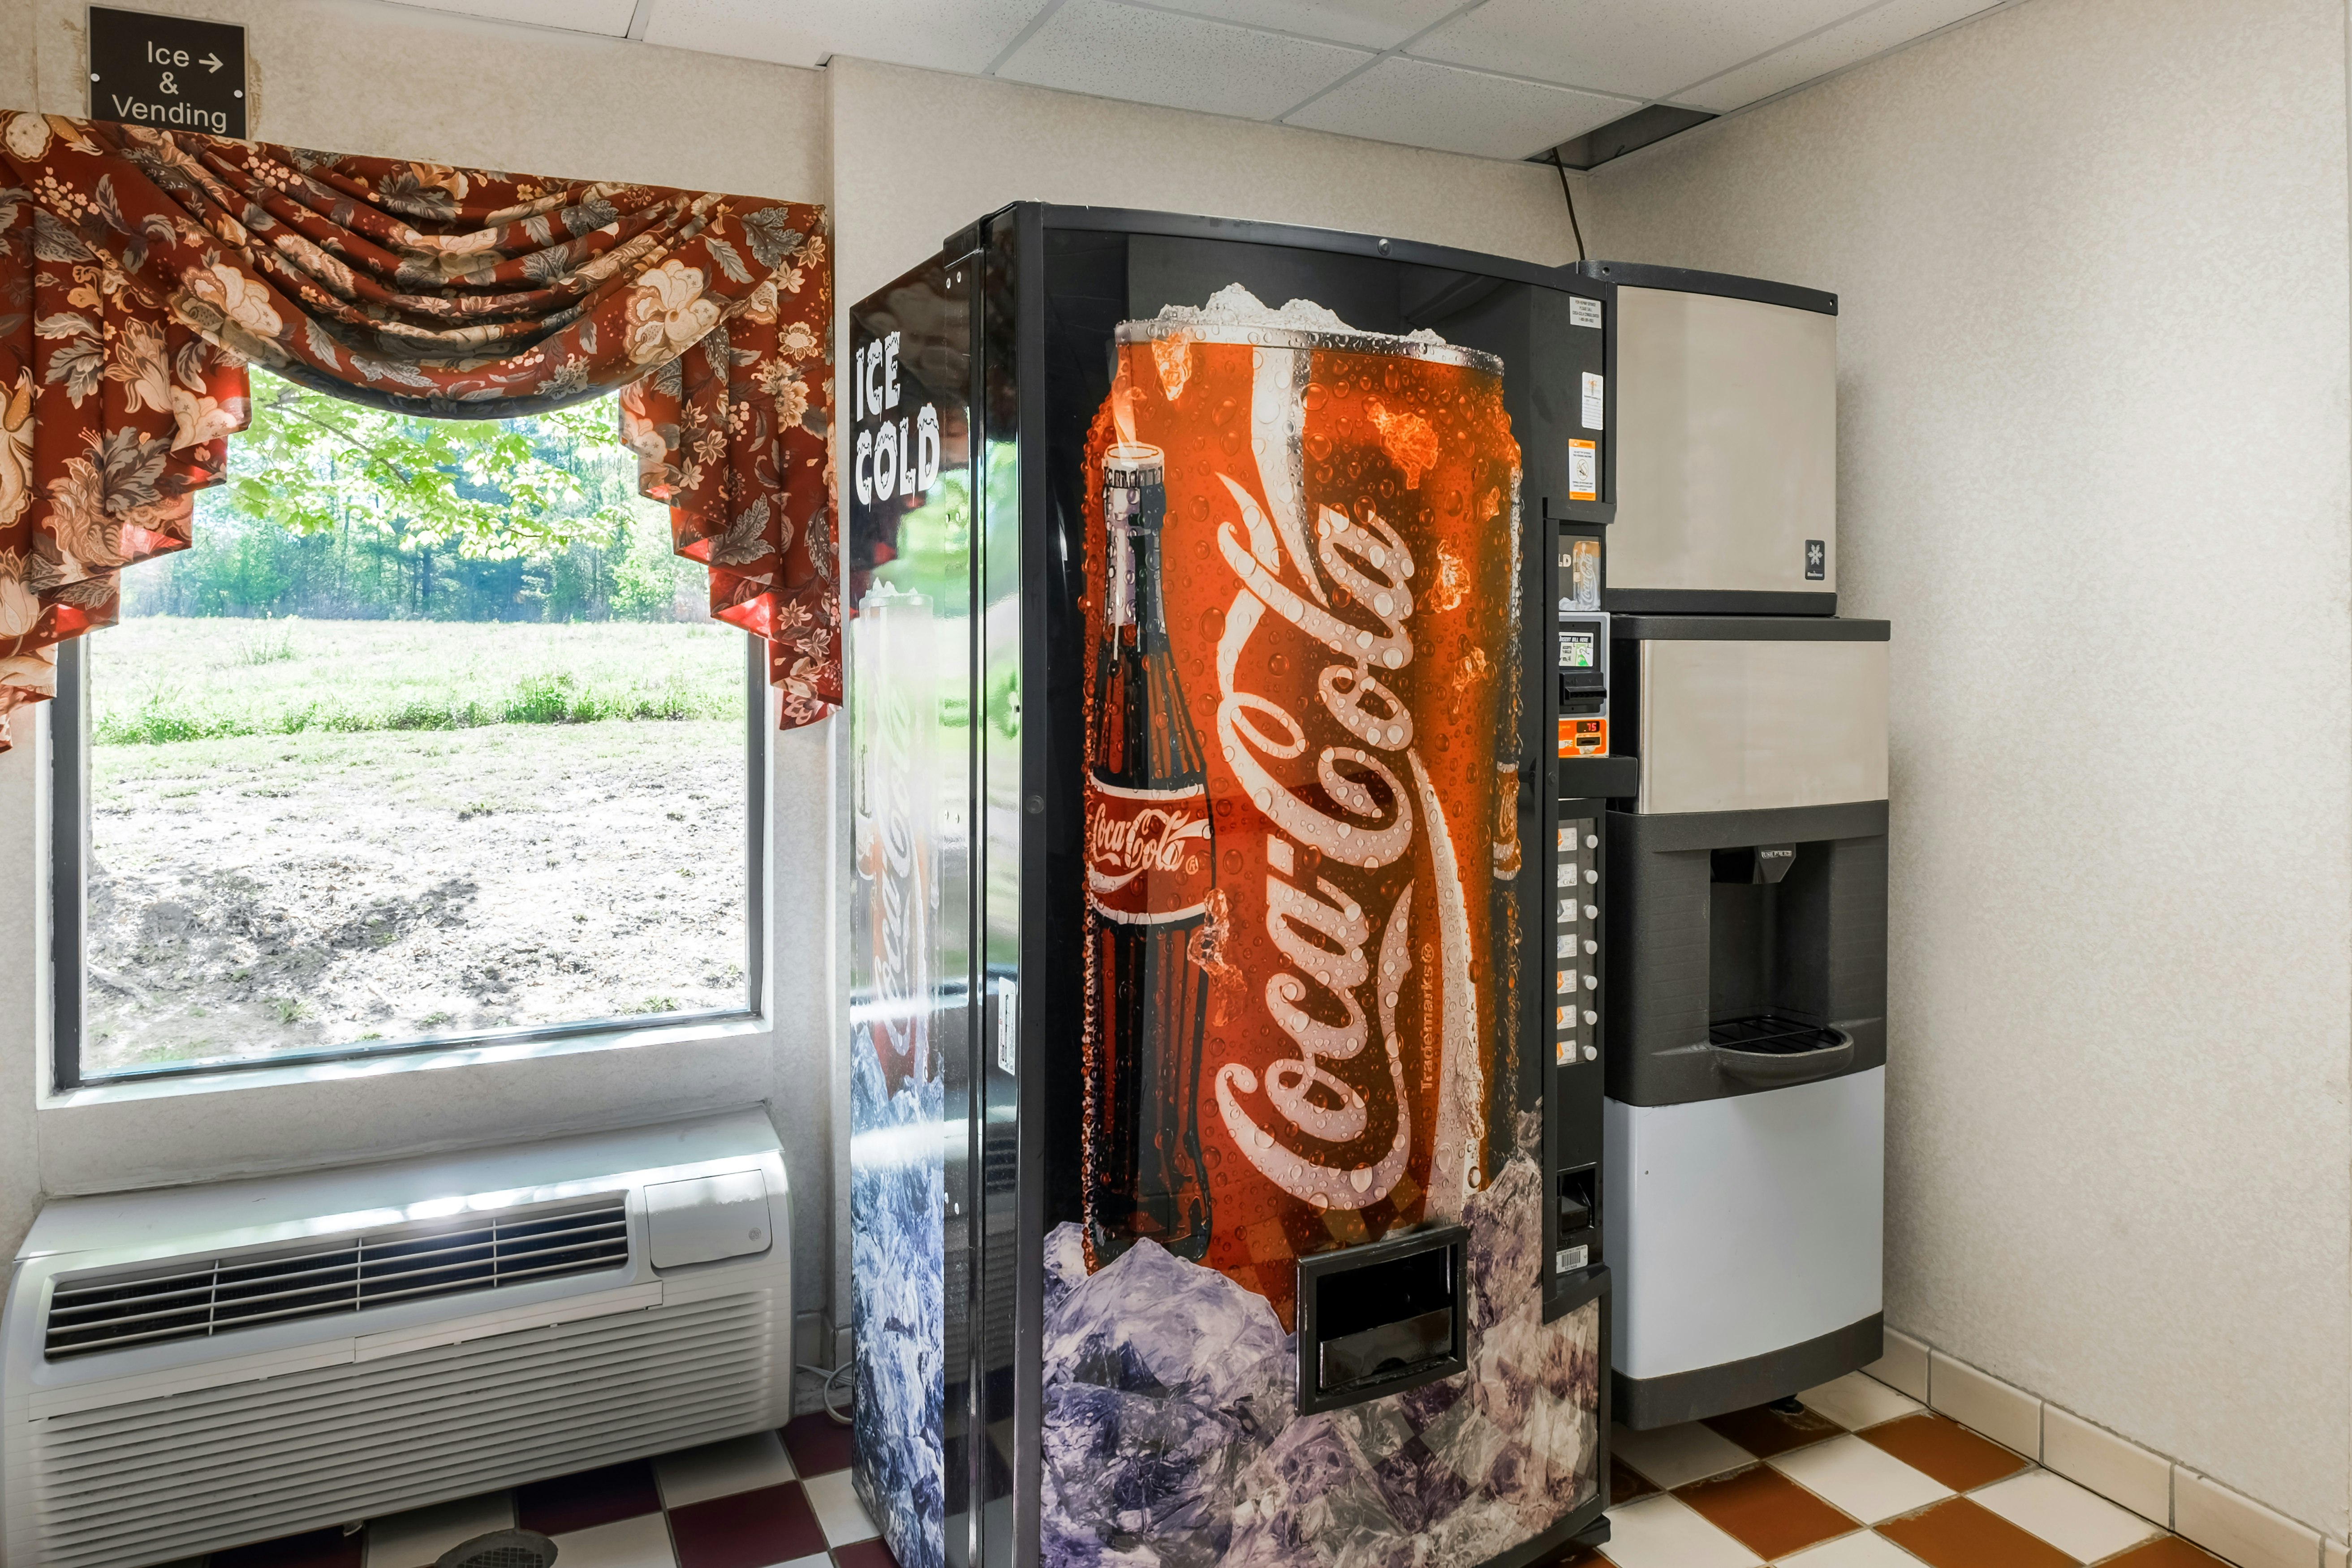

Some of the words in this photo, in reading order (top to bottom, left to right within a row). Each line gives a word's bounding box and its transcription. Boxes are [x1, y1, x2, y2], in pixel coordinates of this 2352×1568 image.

[147, 41, 189, 67] Ice
[159, 71, 179, 95] &
[112, 94, 227, 134] Vending
[856, 331, 900, 422] ICE
[855, 402, 940, 513] COLD
[1093, 803, 1191, 872] Coca-Cola
[1215, 470, 1415, 1211] Coca-Cola
